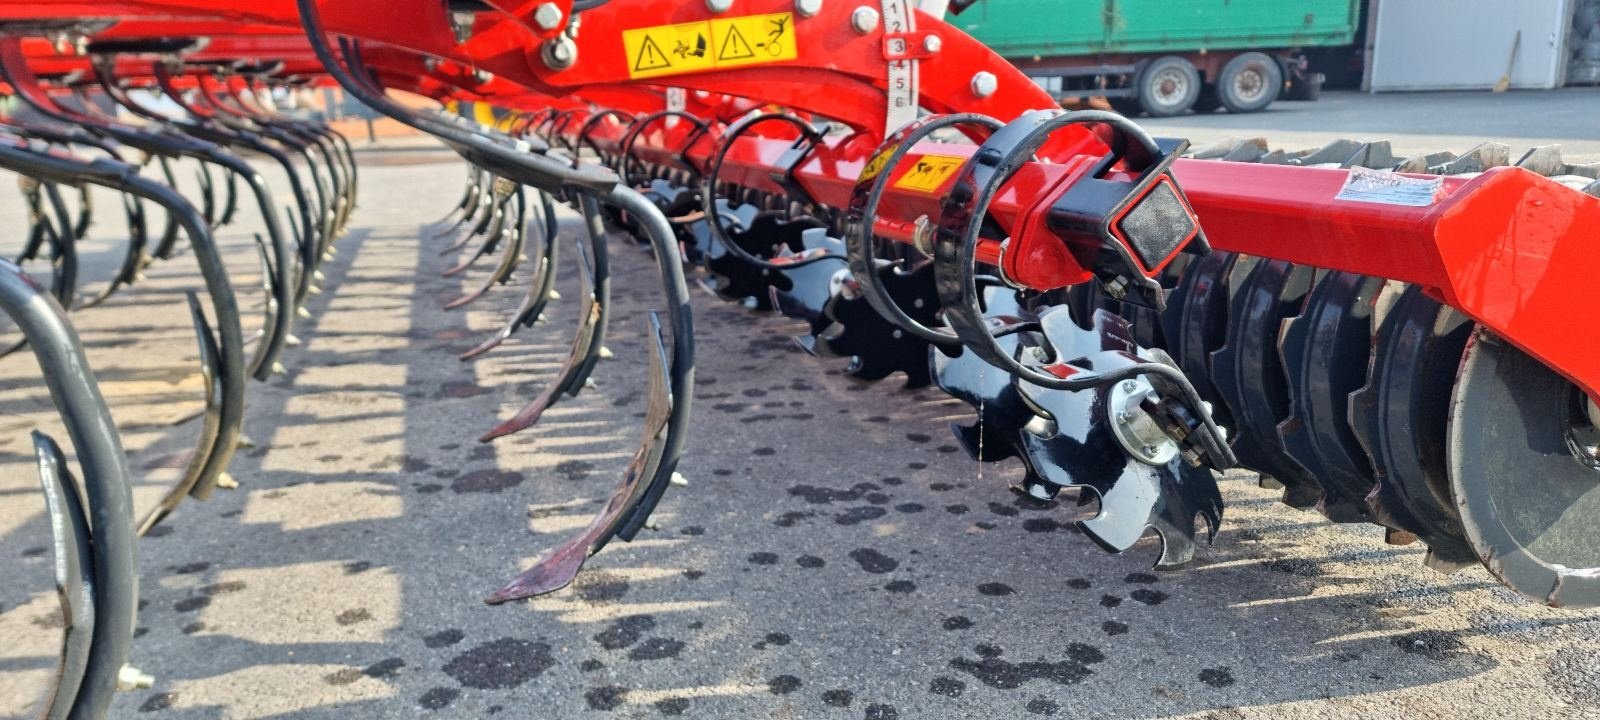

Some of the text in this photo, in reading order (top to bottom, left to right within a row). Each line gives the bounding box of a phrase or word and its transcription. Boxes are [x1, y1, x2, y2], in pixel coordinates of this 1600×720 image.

[890, 2, 897, 14] 1
[892, 21, 901, 33] 2
[895, 40, 904, 53] 3
[896, 78, 904, 89] 5
[895, 96, 904, 108] 6
